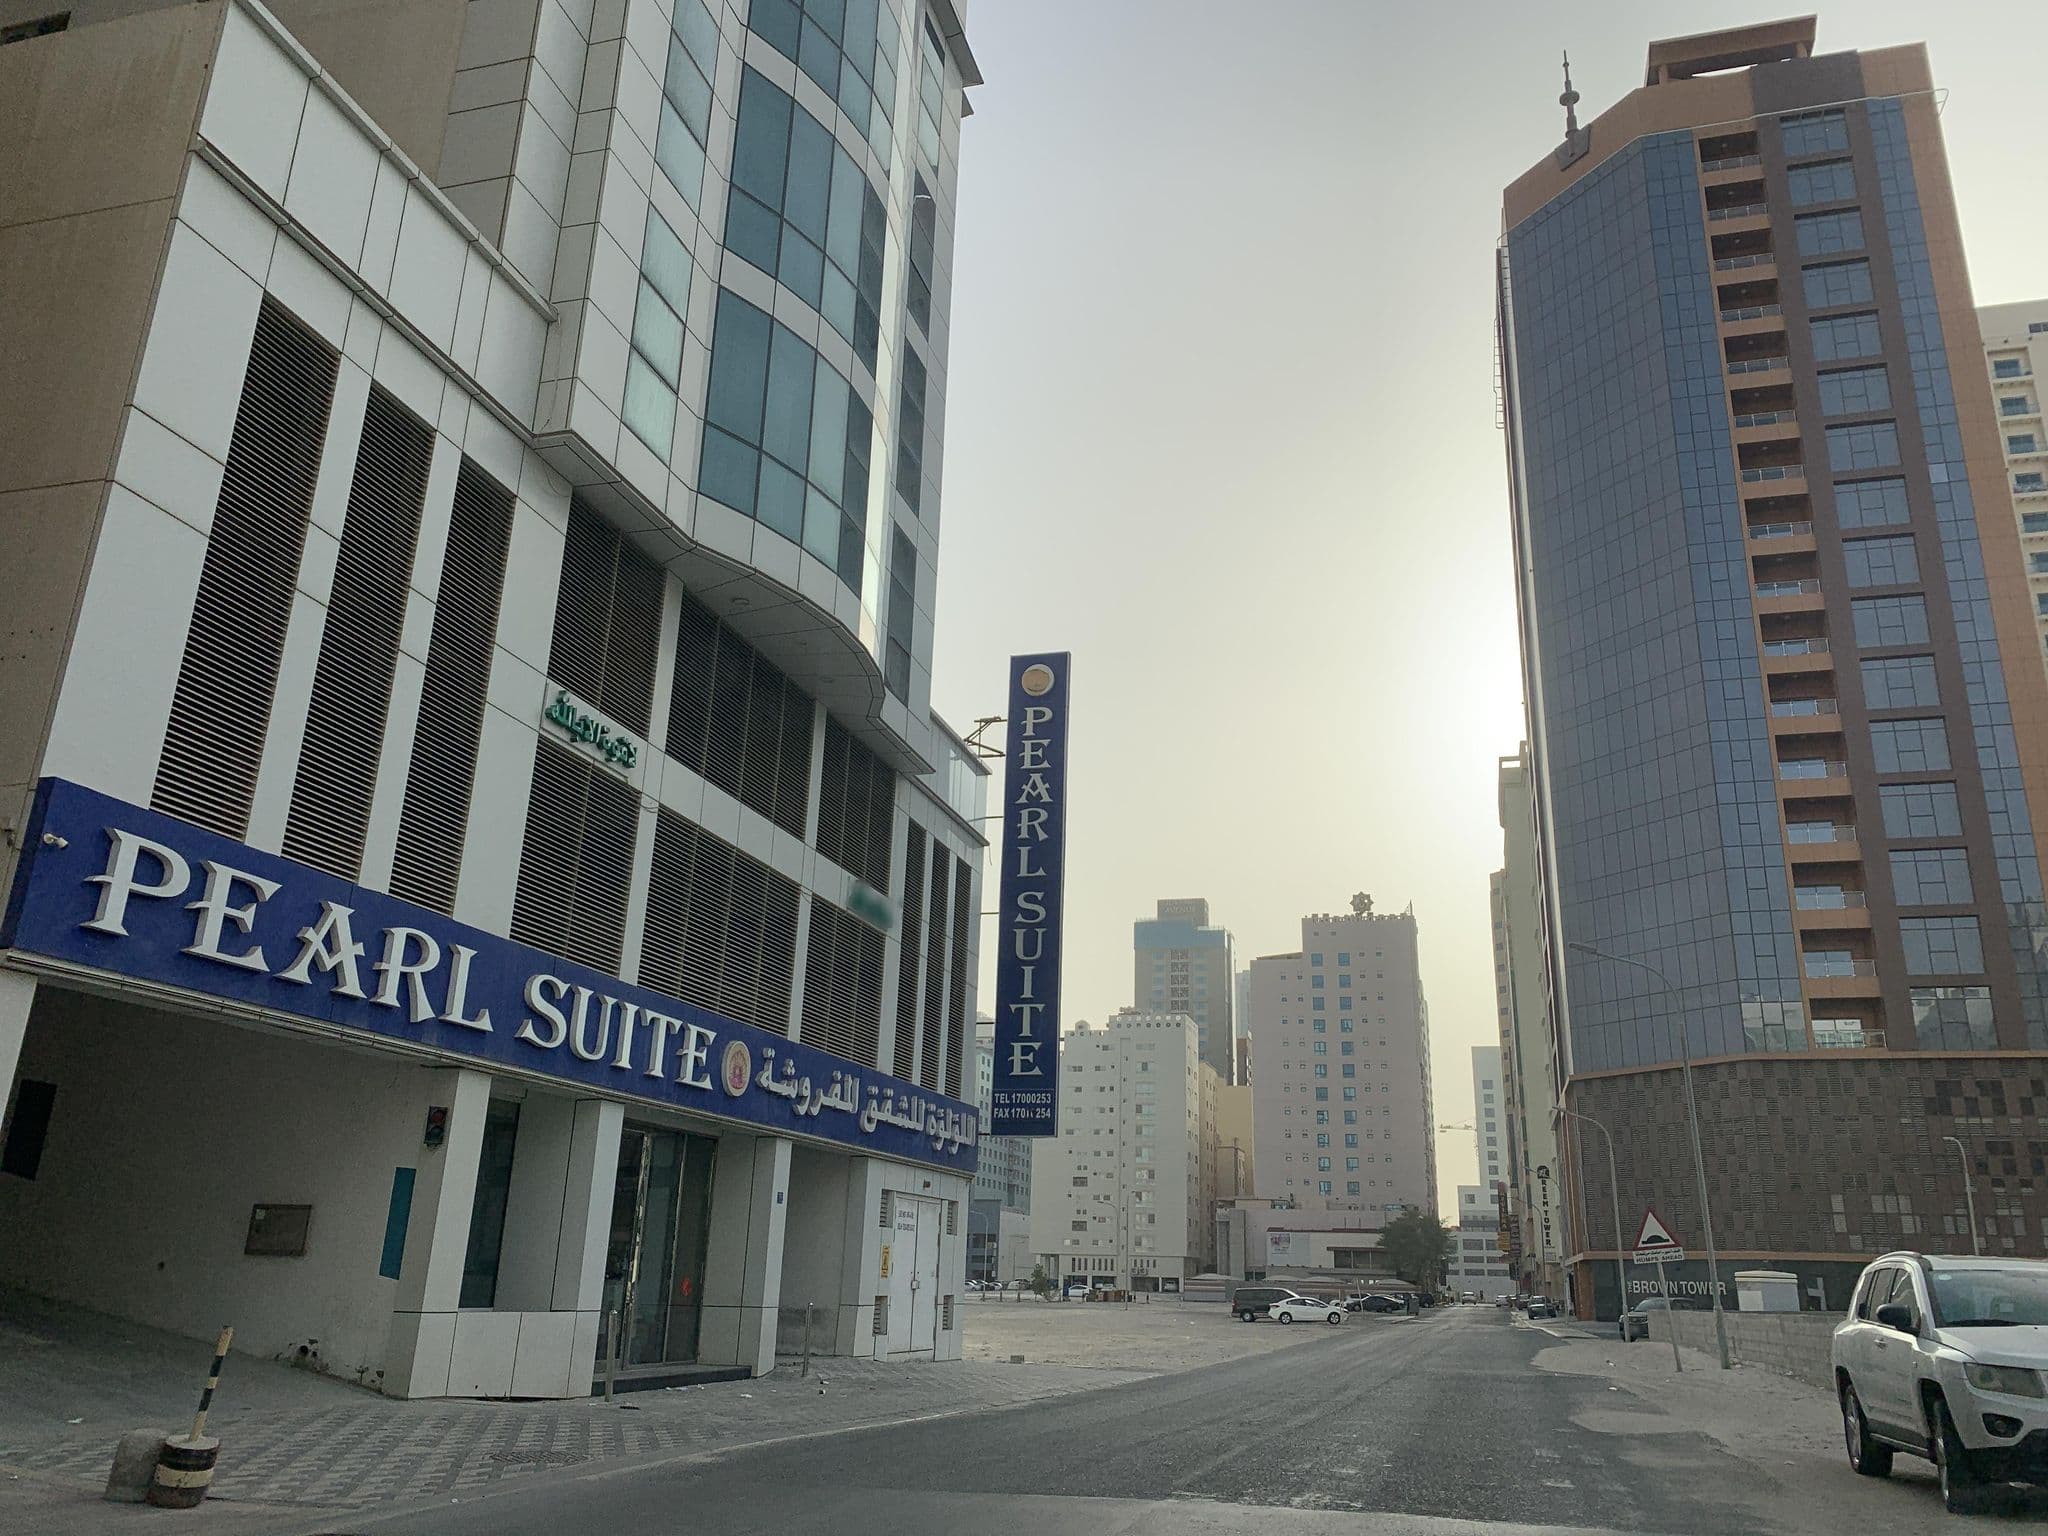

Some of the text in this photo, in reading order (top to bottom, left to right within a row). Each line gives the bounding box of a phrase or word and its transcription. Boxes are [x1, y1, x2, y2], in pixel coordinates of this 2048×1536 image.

[1008, 706, 1053, 1077] PEARL SUITE
[80, 827, 717, 1090] PEARL SUITE
[860, 1085, 925, 1133] للشقق
[993, 1107, 1010, 1119] FAX
[994, 1093, 1051, 1104] TEL 17000253
[1541, 1180, 1549, 1207] REEM
[1543, 1210, 1552, 1246] TOWER
[1632, 1280, 1678, 1294] BROWN
